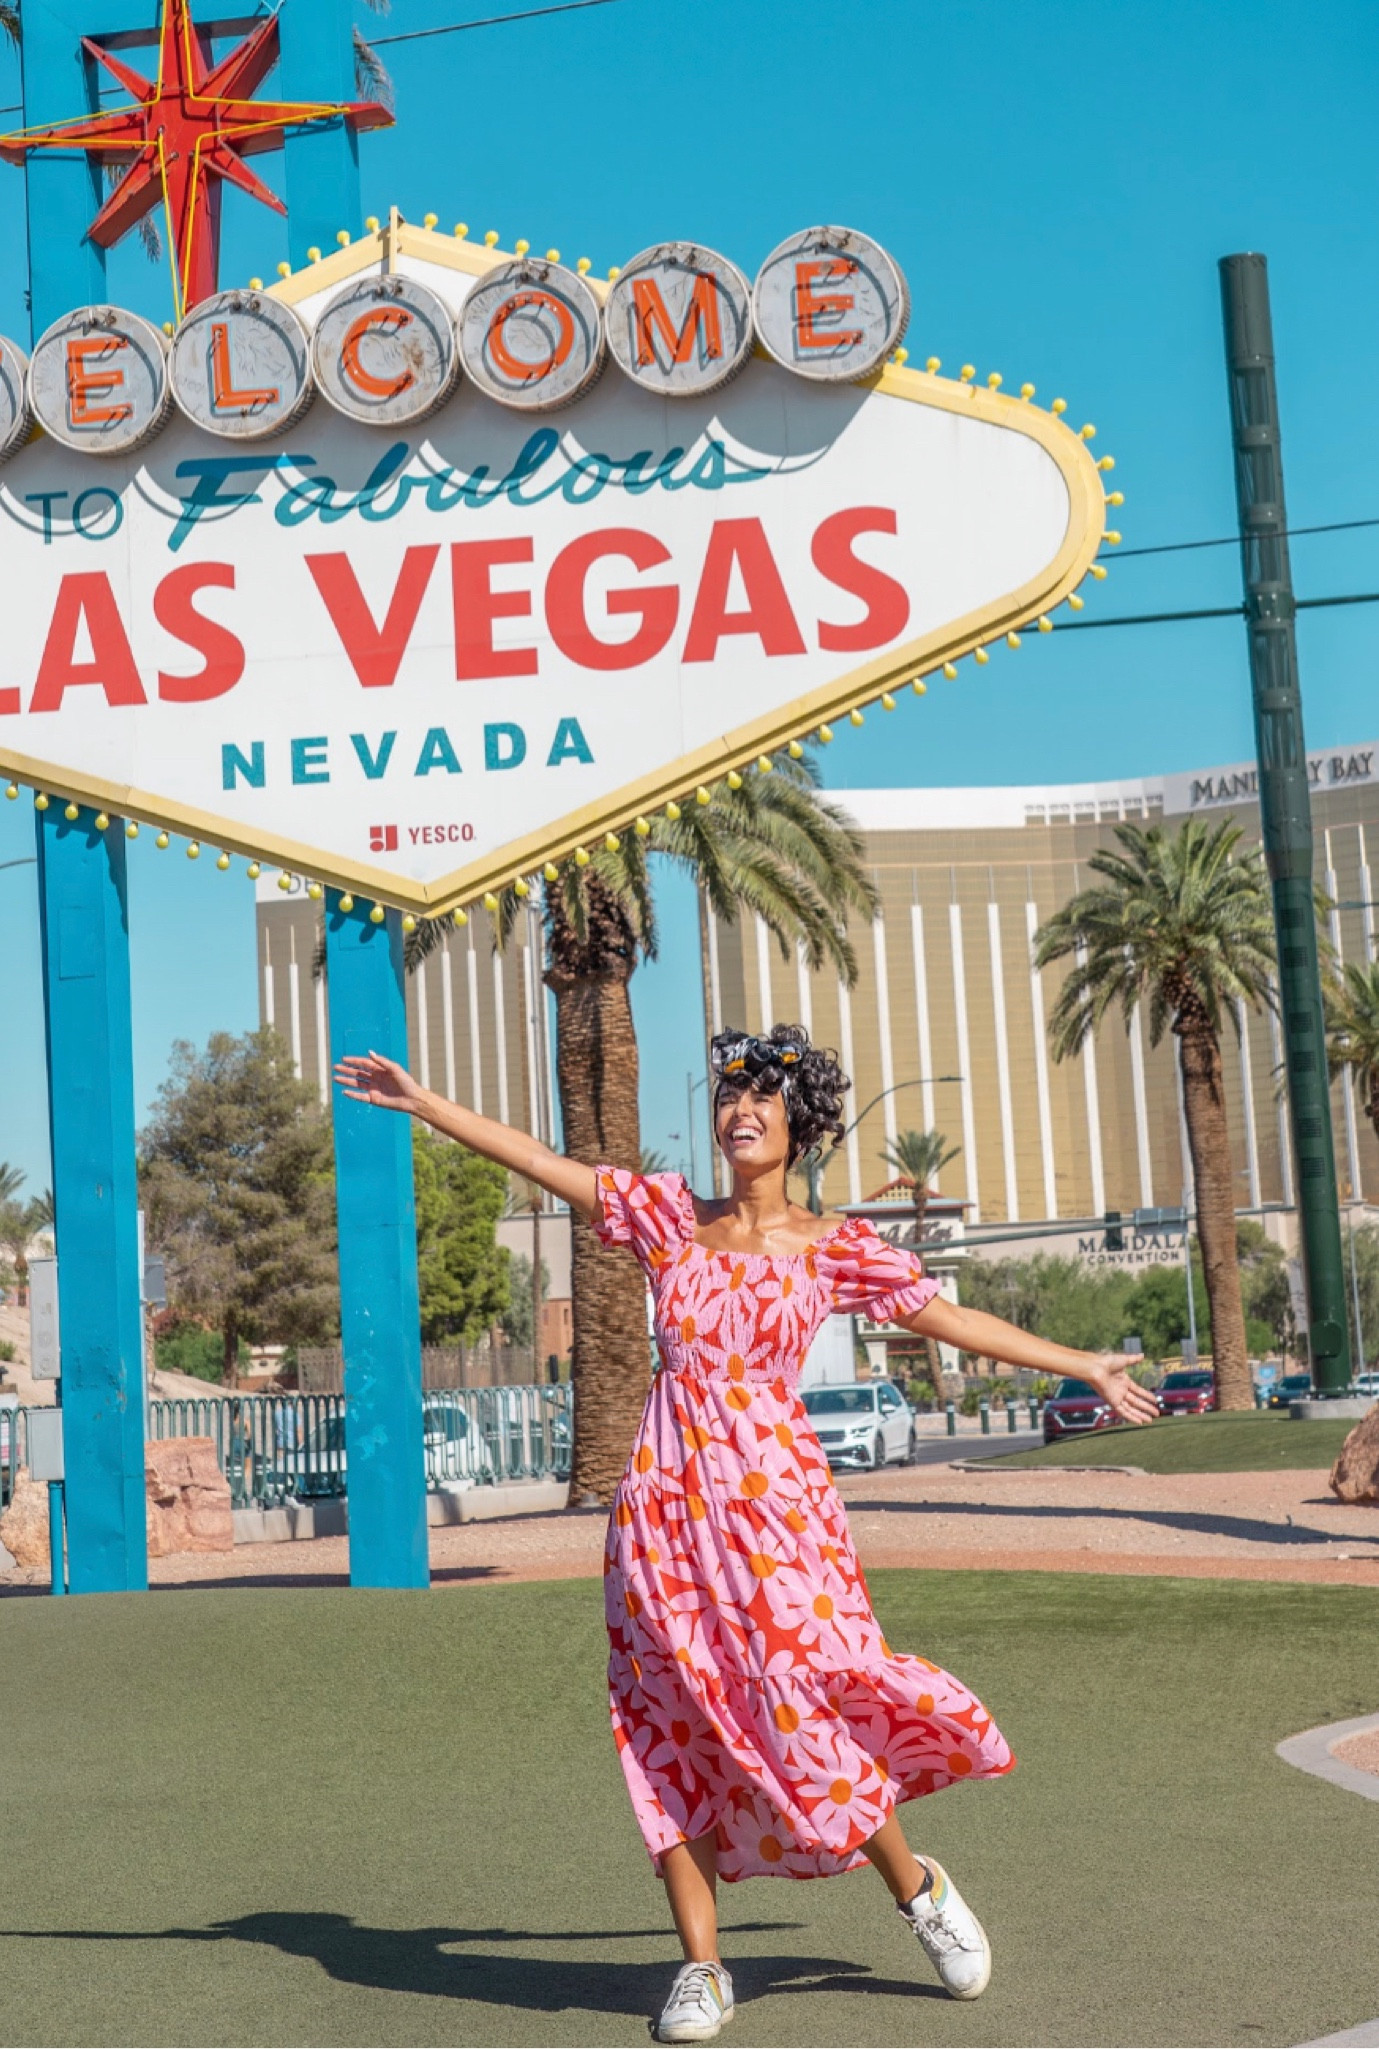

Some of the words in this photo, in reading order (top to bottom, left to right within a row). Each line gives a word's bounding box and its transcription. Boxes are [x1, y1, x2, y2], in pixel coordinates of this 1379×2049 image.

[0, 257, 864, 424] ELCOME
[25, 486, 124, 545] TO
[167, 427, 773, 552] Fabulous
[304, 505, 911, 689] VEGAS
[221, 717, 595, 791] NEVADA
[1331, 751, 1374, 781] BAY
[1087, 1251, 1179, 1265] CONVENTION
